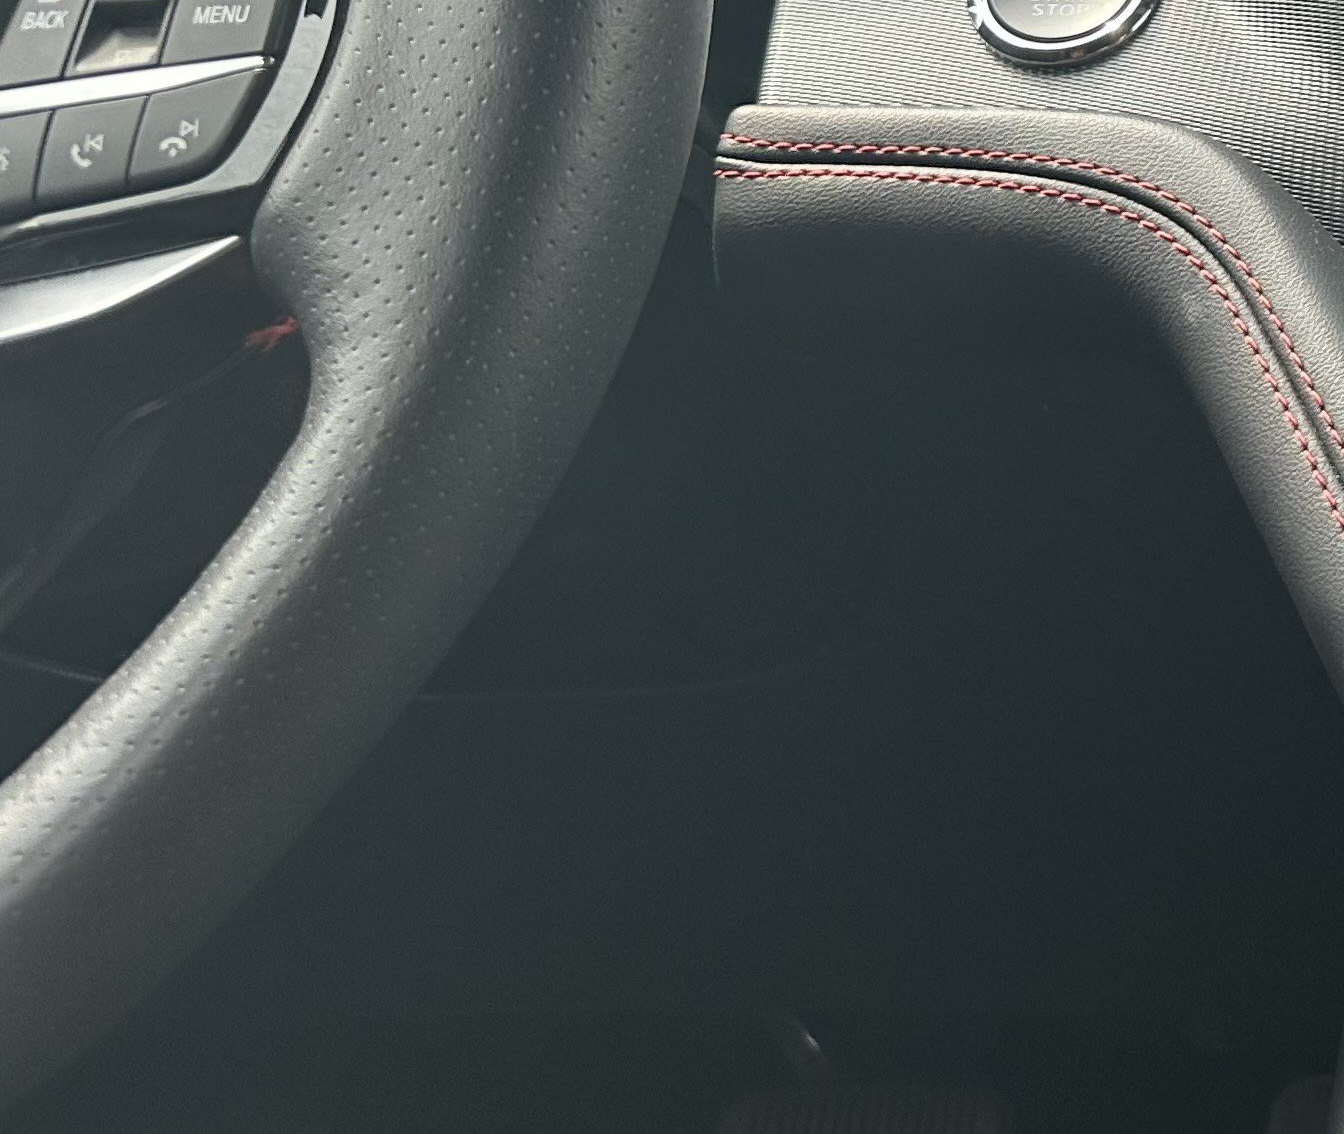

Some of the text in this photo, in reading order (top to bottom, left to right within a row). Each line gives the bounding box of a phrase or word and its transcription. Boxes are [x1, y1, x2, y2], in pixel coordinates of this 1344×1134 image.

[19, 9, 70, 31] BACK
[192, 4, 251, 25] MENU
[1031, 3, 1089, 17] STOP
